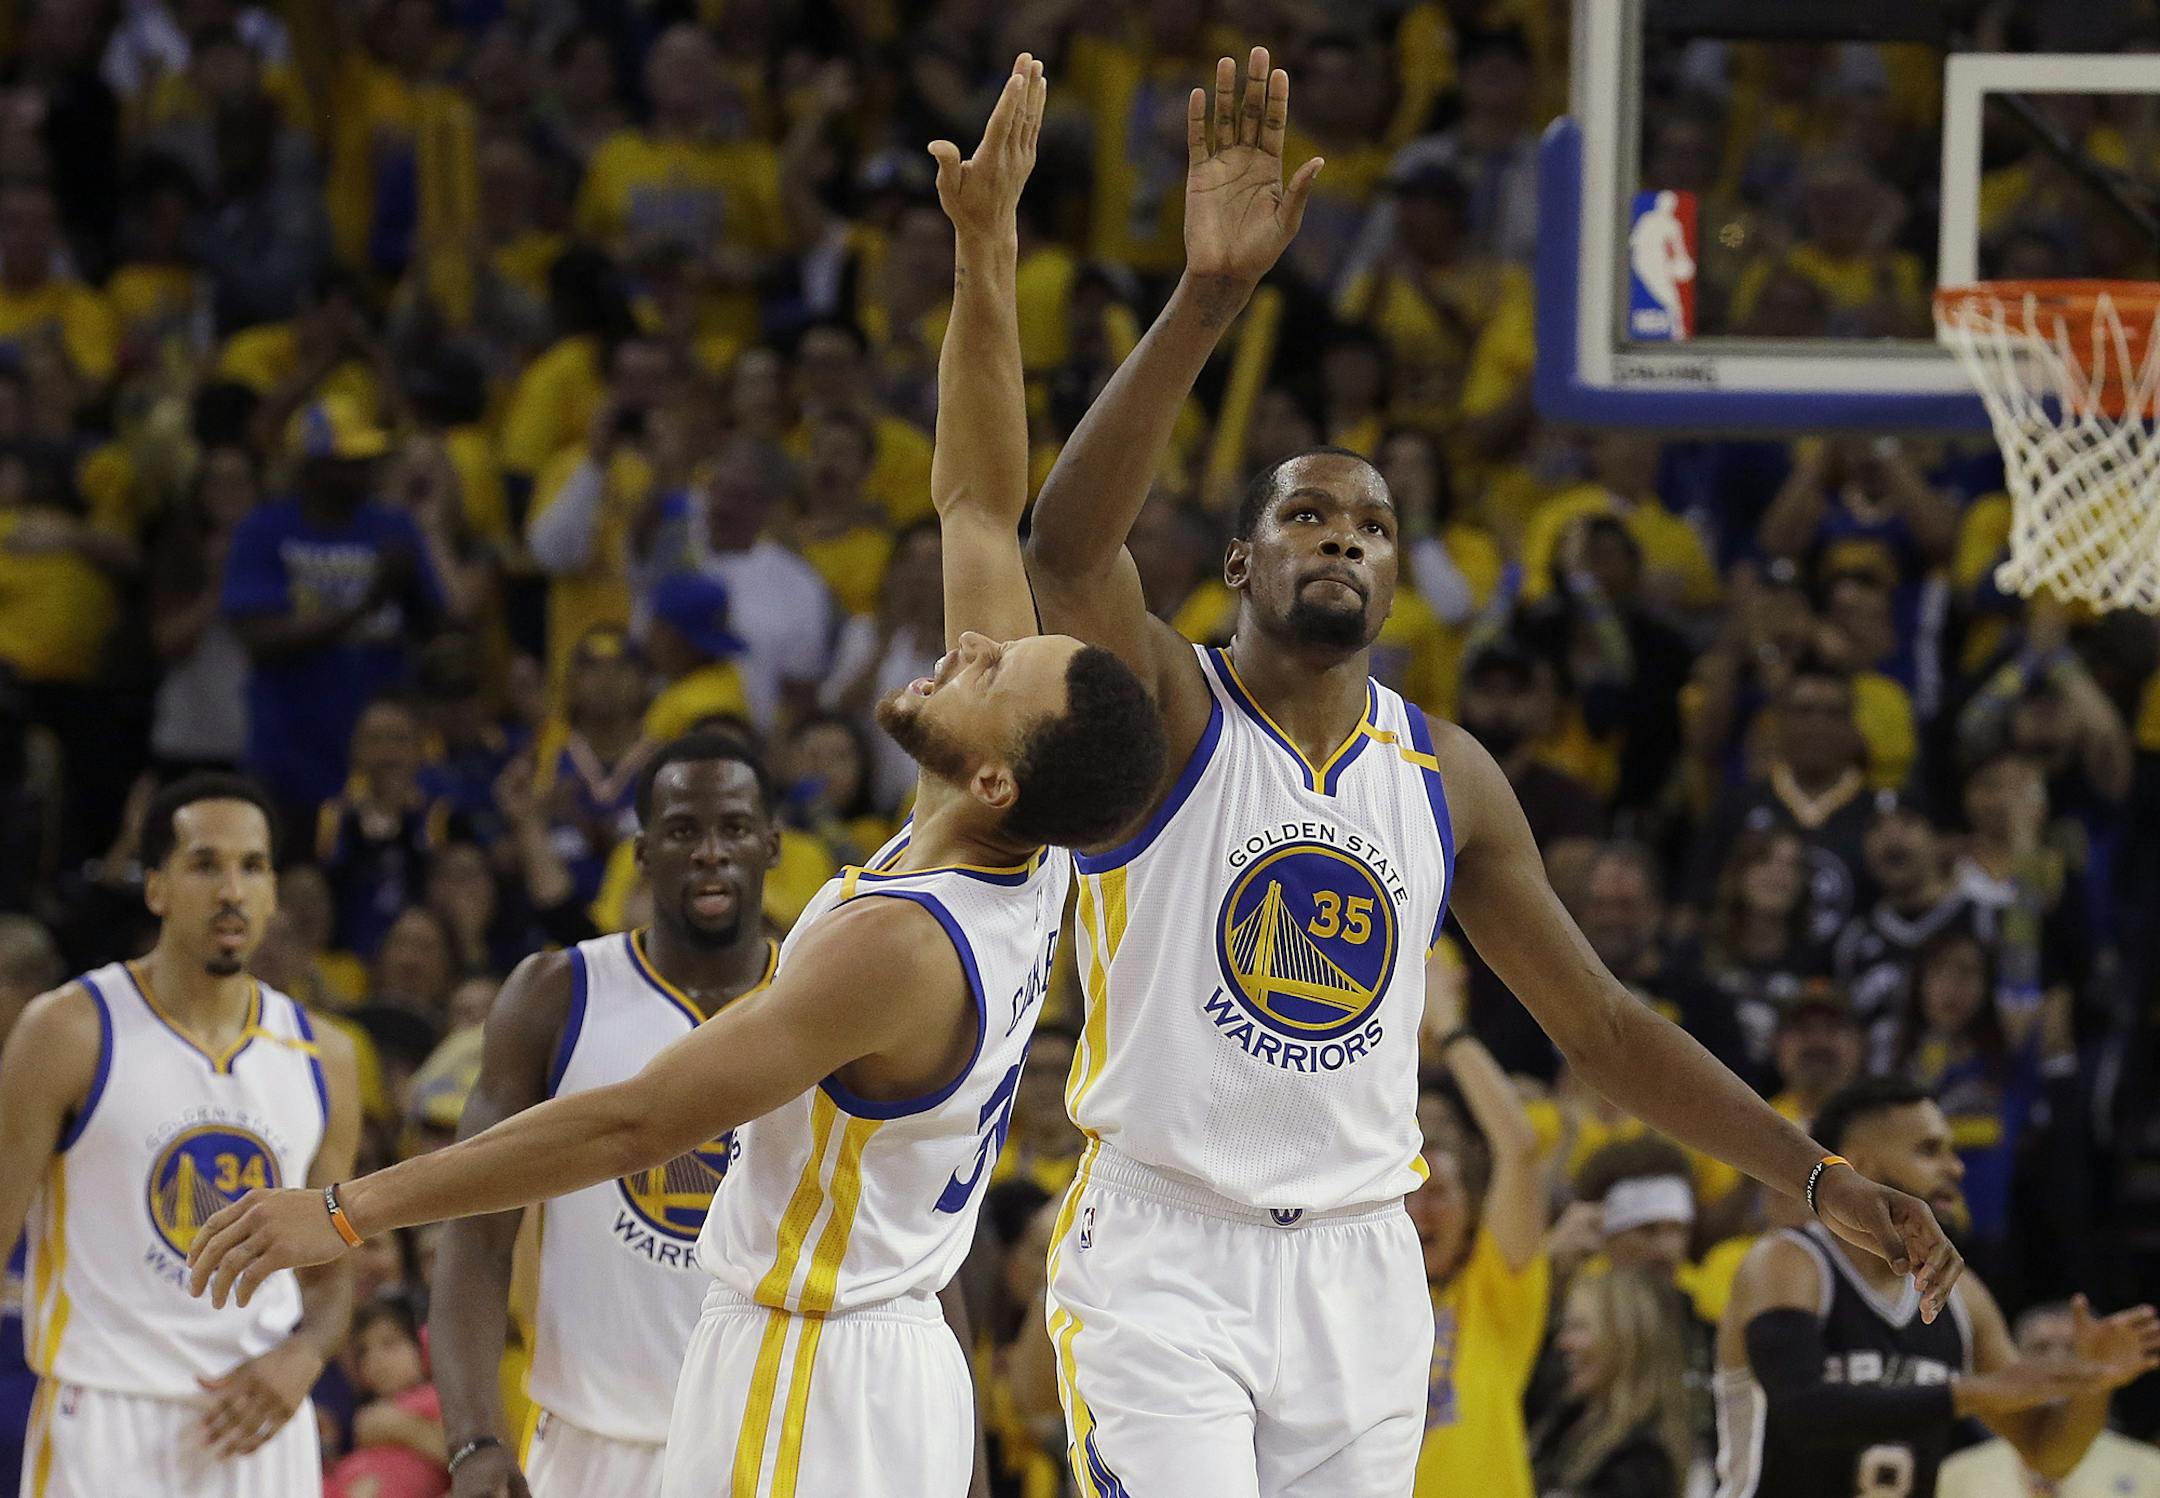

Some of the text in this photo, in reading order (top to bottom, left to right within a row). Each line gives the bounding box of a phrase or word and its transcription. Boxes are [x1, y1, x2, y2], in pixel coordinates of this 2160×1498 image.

[1228, 822, 1409, 906] GOLDEN STATE
[1307, 889, 1374, 945] 35
[1203, 985, 1384, 1073] WARRIORS
[214, 1151, 267, 1193] 34
